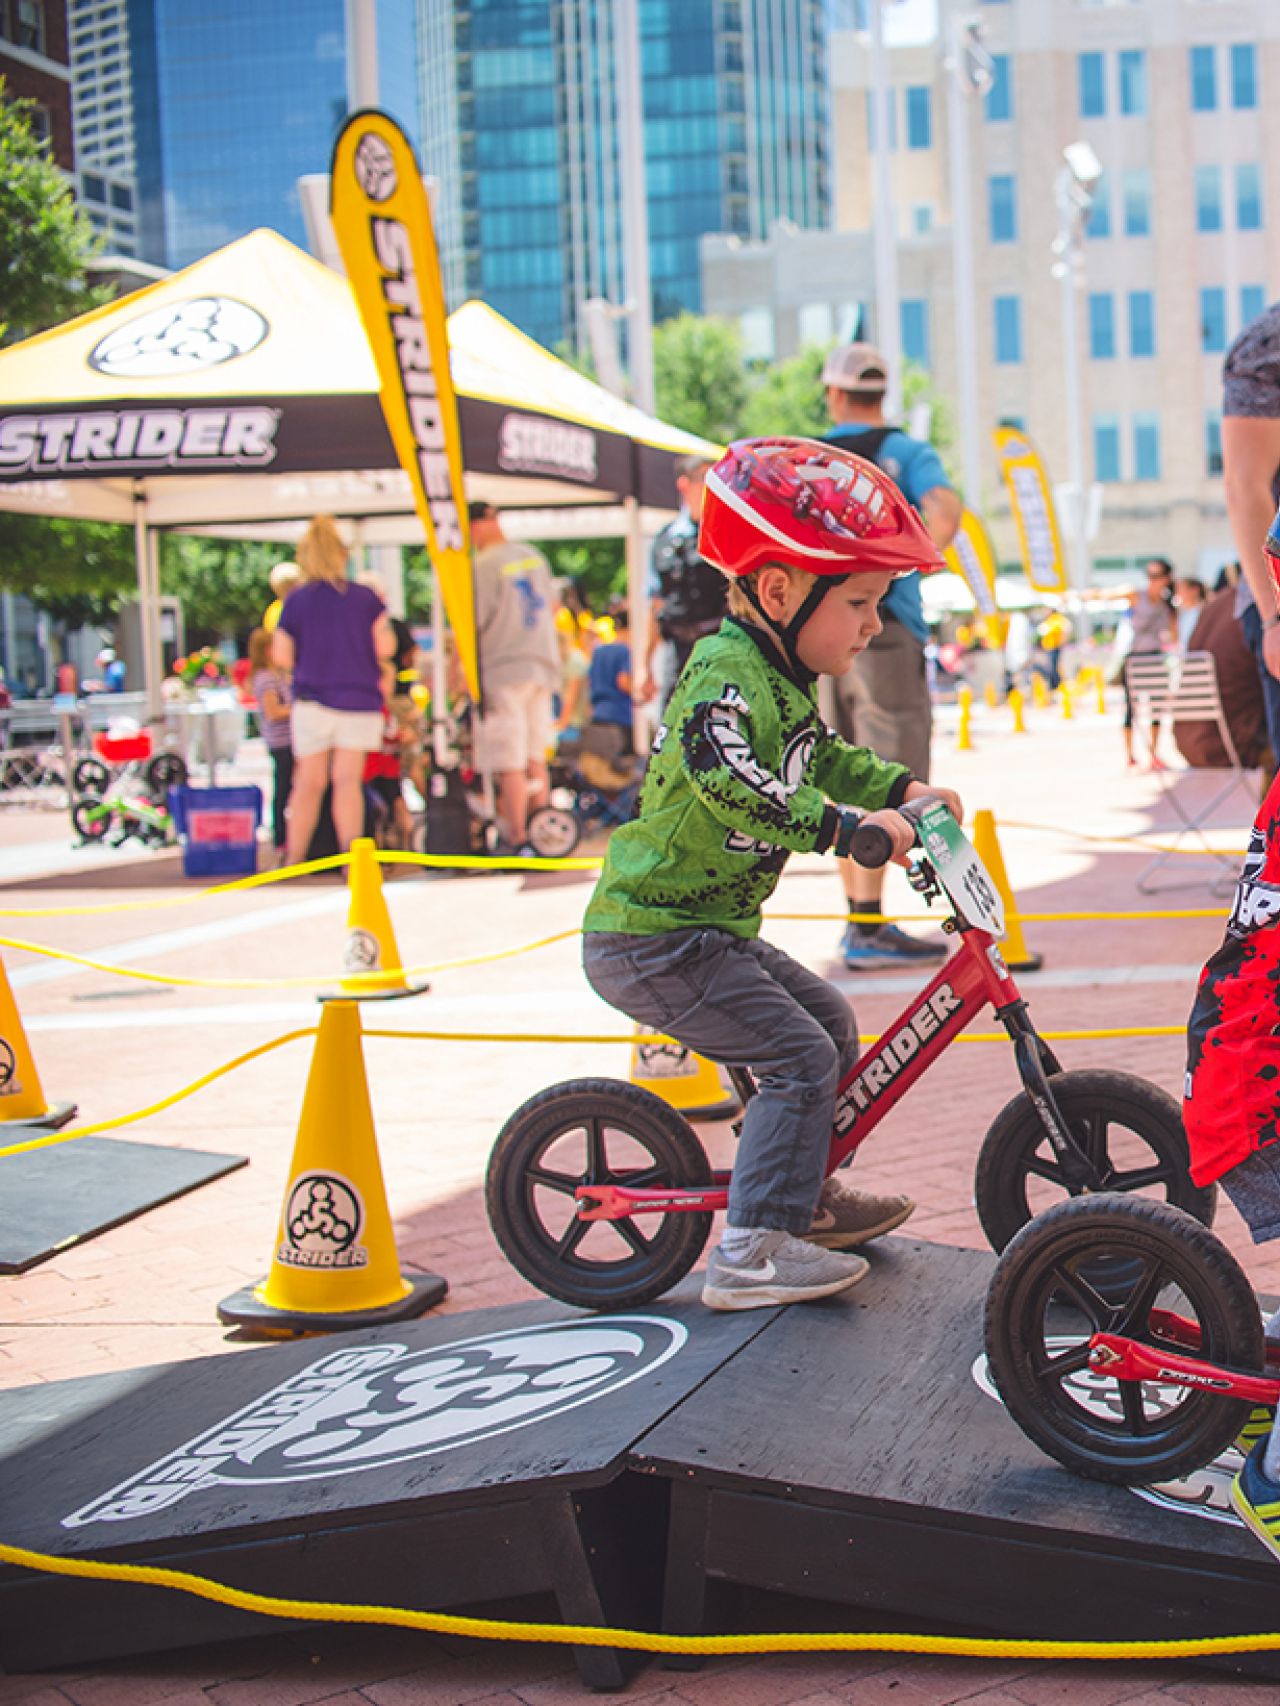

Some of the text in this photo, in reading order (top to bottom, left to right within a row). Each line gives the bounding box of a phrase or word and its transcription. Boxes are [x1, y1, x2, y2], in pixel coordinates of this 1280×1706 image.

[0, 408, 279, 474] STRIDER
[369, 213, 463, 553] STRIDER
[832, 981, 964, 1138] STRIDER
[277, 1245, 369, 1268] STRIDER
[60, 1344, 408, 1528] STRIDER
